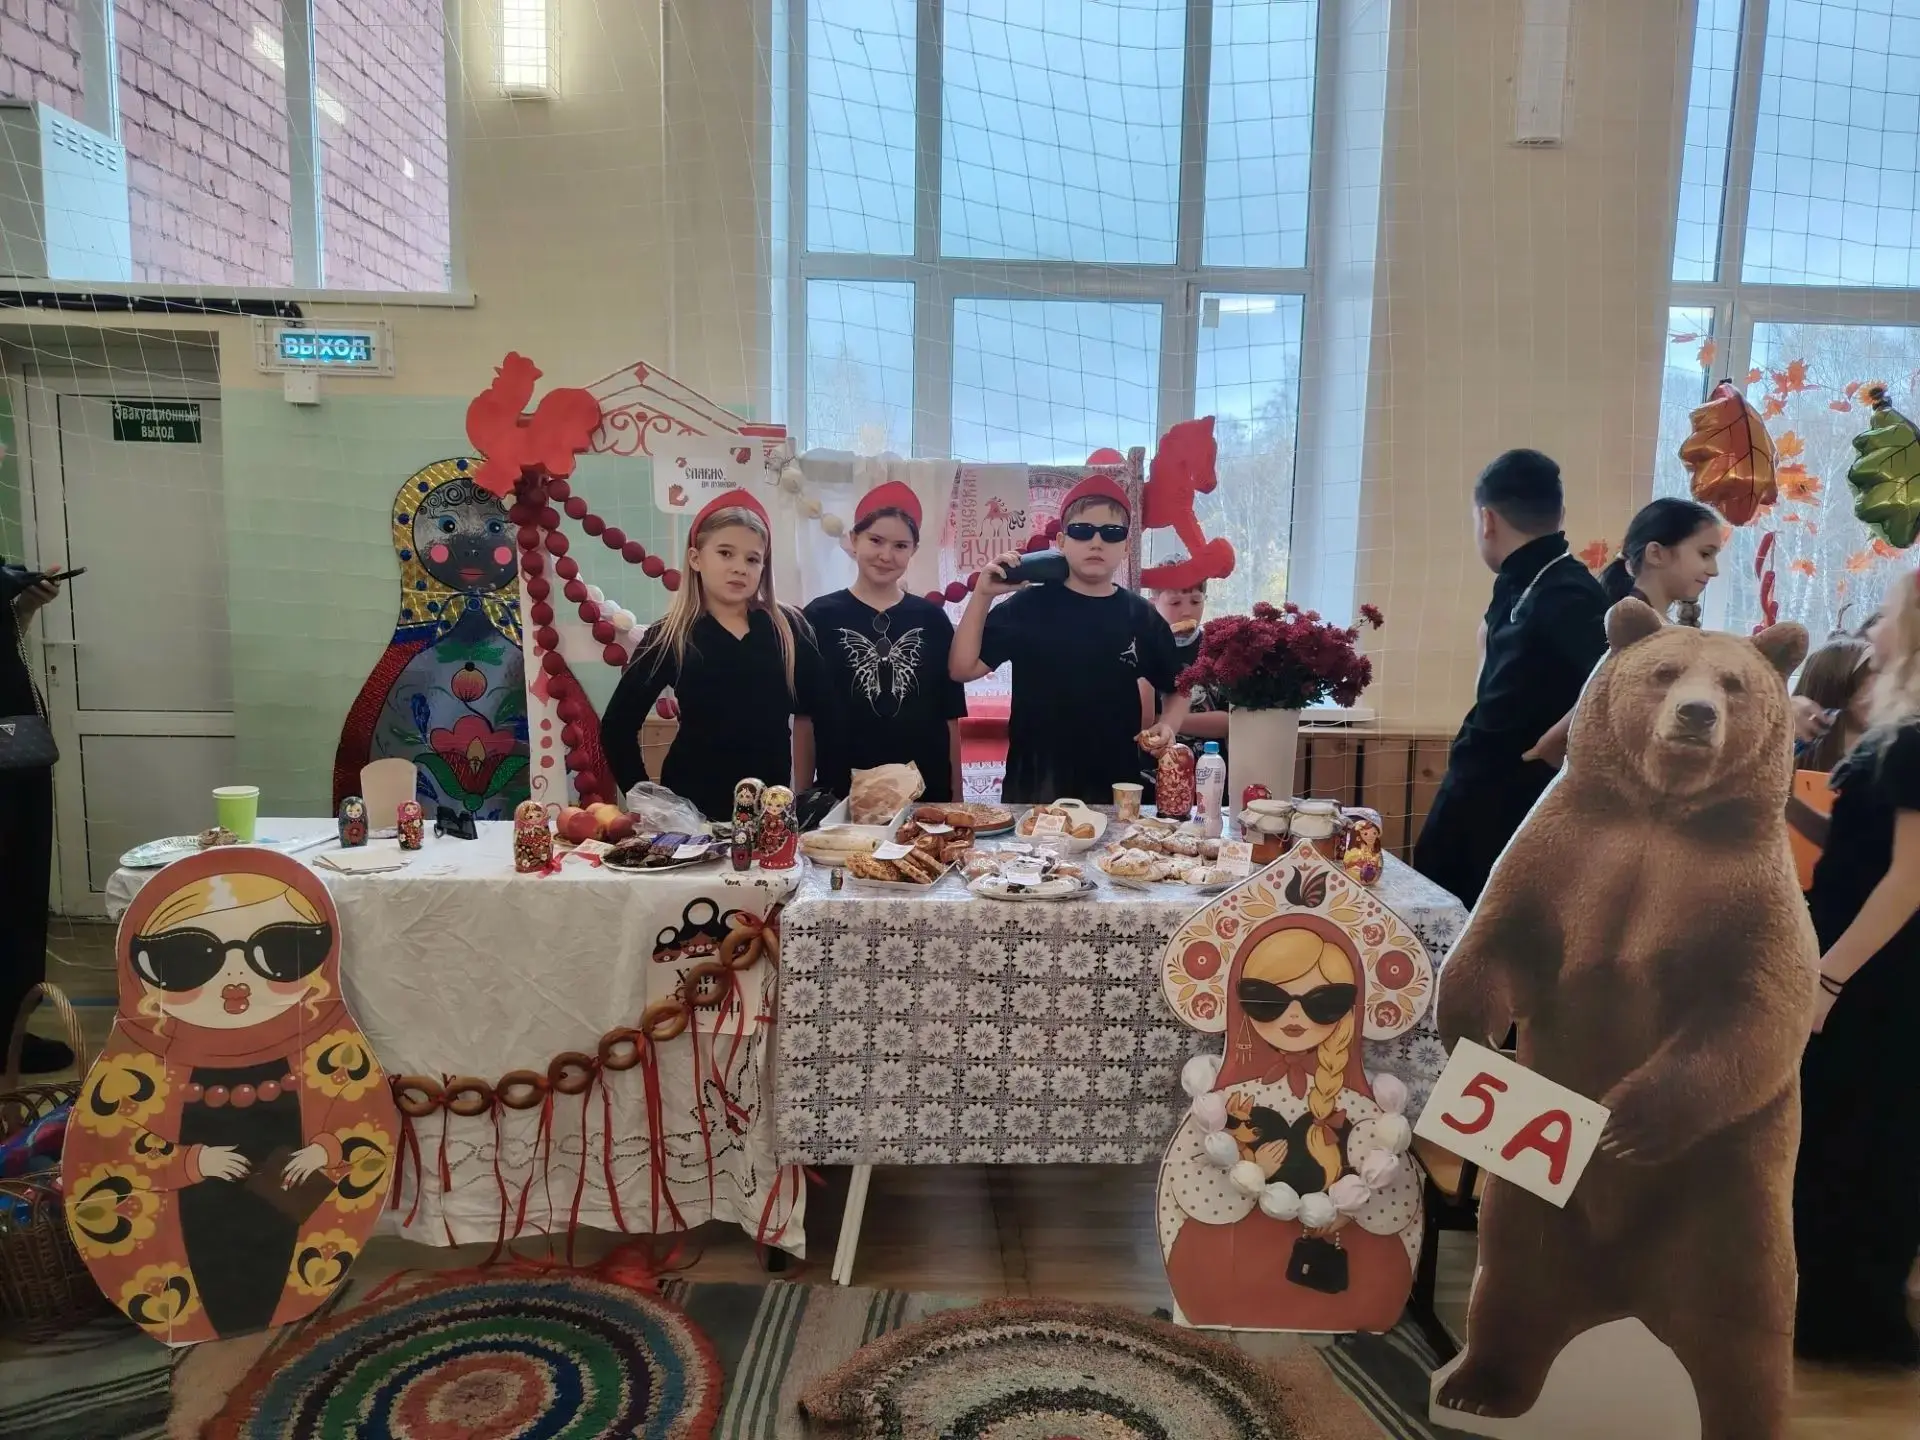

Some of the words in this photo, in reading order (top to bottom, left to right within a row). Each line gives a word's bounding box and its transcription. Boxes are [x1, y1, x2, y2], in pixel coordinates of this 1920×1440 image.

[284, 337, 367, 360] ВЫХОД
[114, 404, 200, 424] Эвакуационный
[1441, 1072, 1508, 1134] 5
